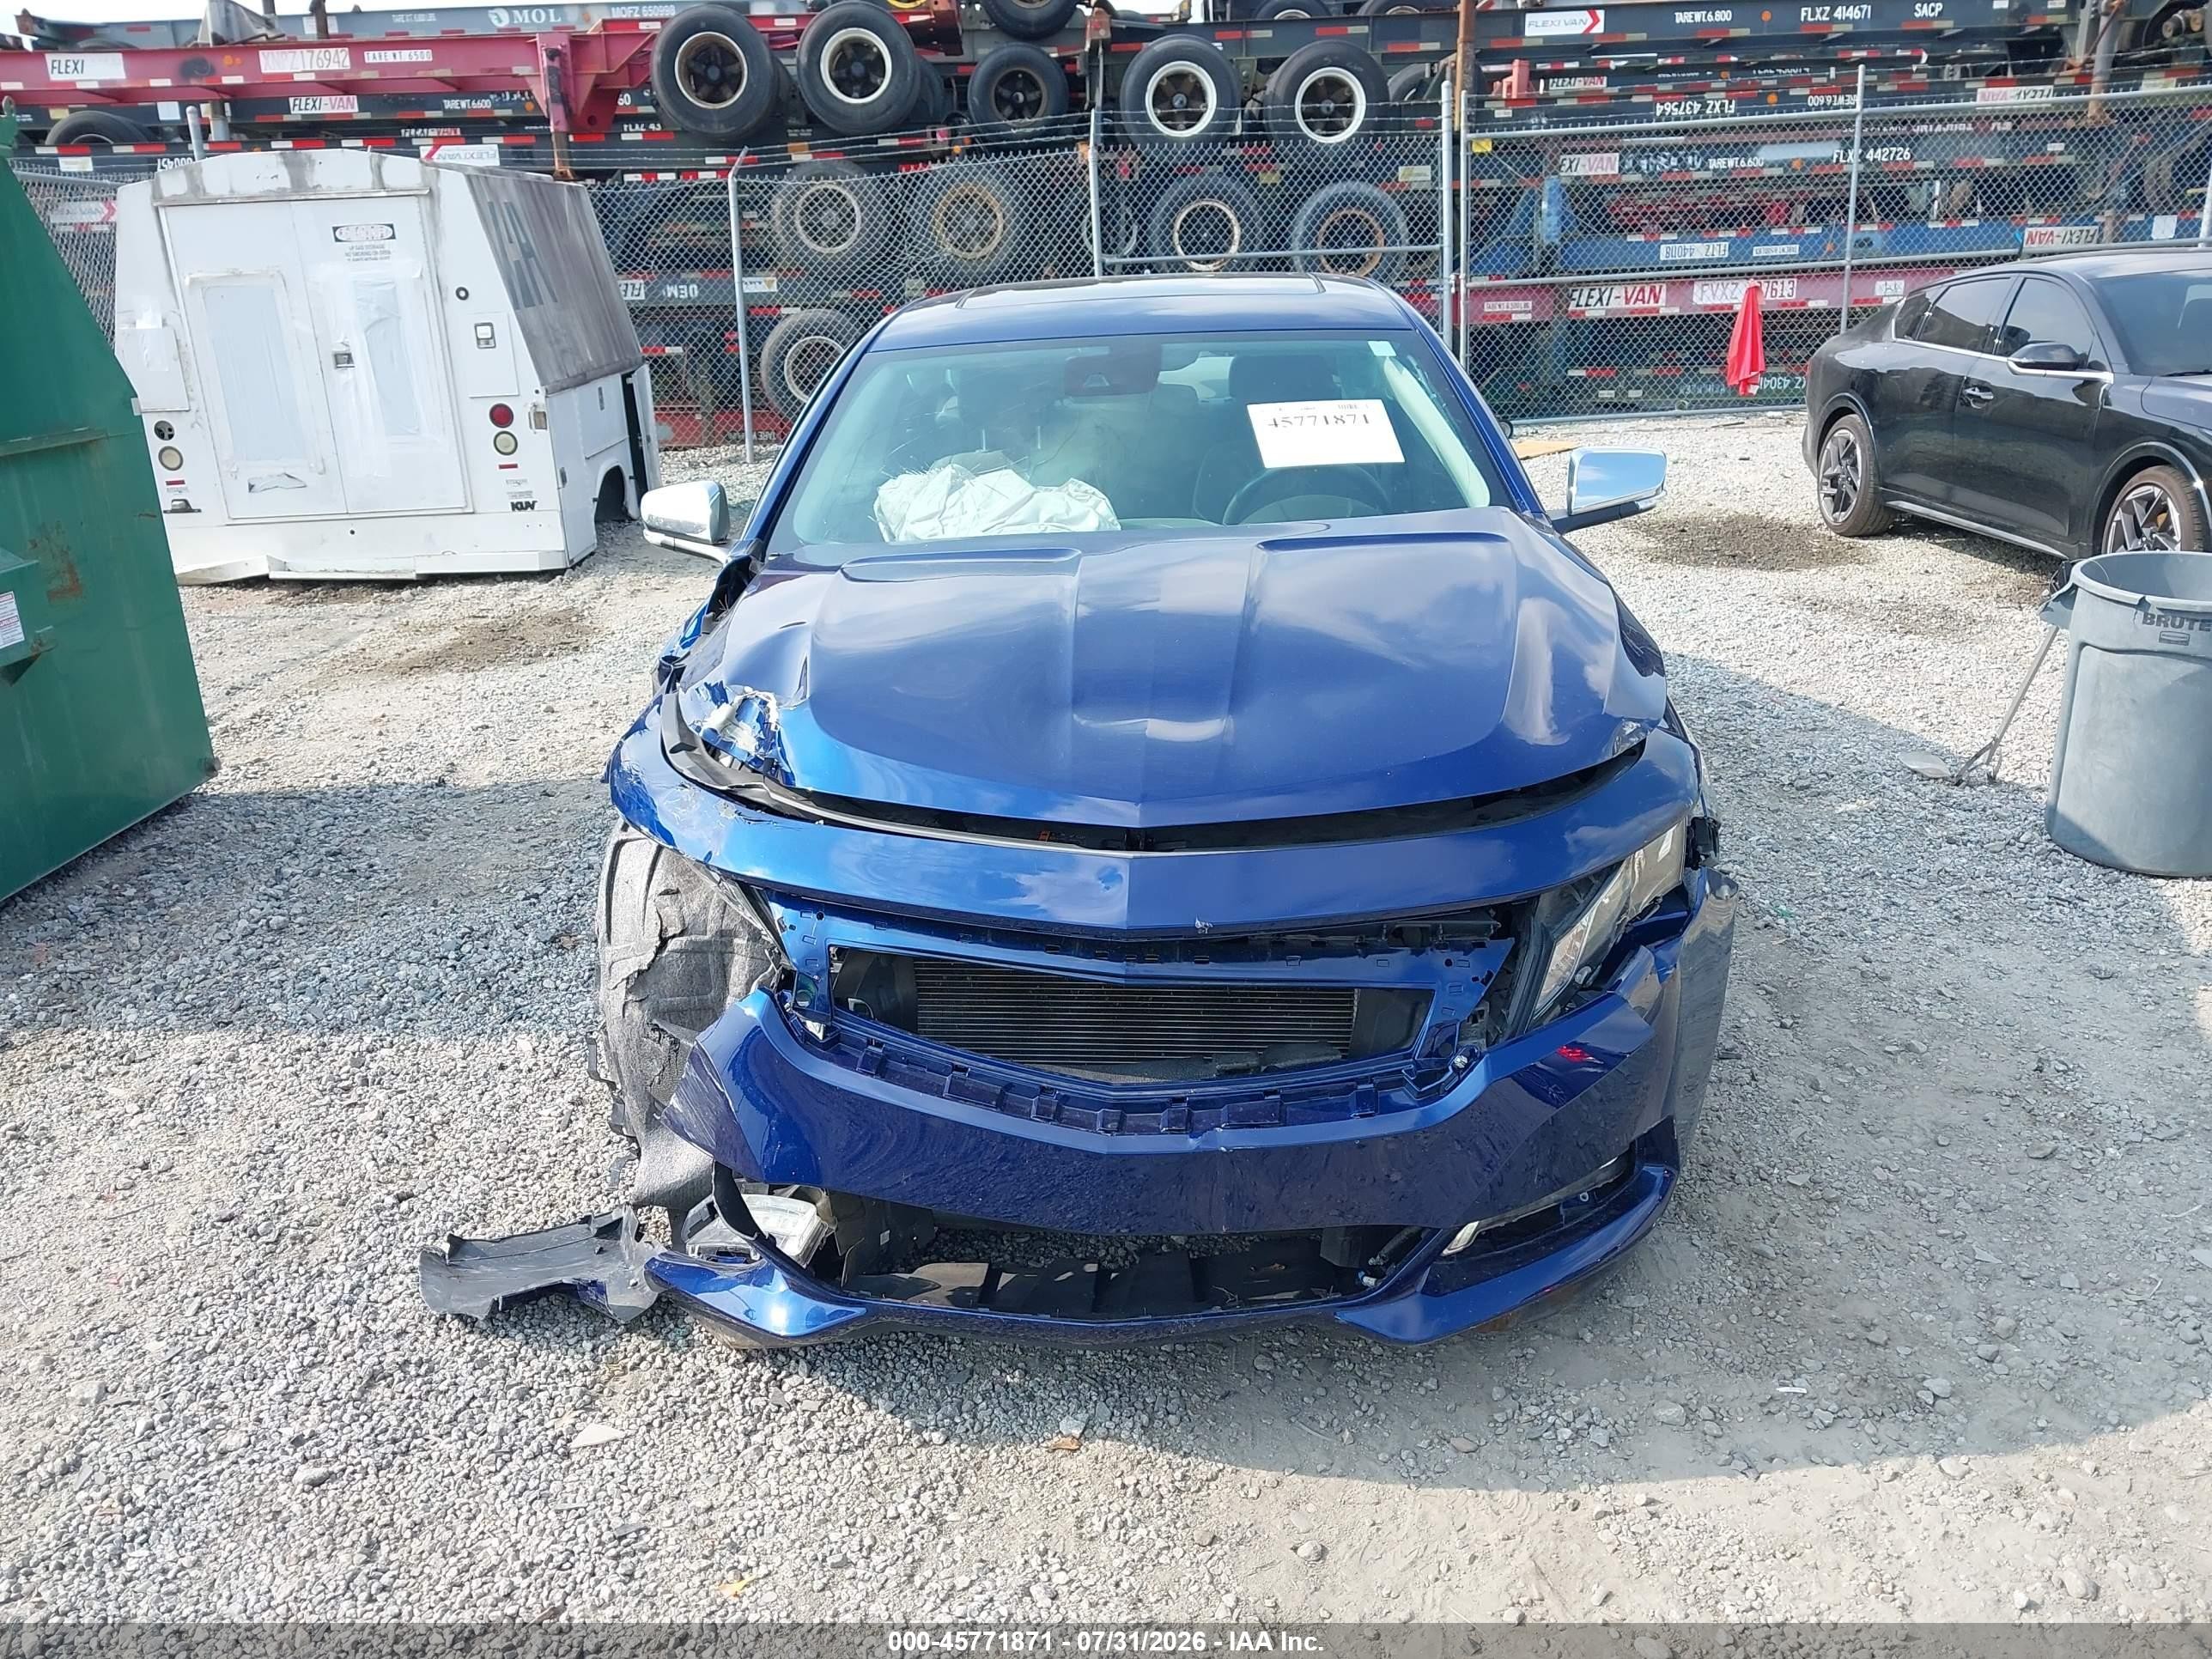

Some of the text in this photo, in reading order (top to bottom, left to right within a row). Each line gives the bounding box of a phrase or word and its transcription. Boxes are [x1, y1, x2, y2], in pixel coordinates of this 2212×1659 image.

[513, 9, 562, 24] MOL
[1801, 4, 1871, 21] FLXZ 414671
[1914, 3, 1943, 17] SACP
[51, 58, 85, 75] FLEXI
[292, 98, 356, 113] FLEXI-VAN
[1656, 100, 1735, 117] FLXZ 437564
[1865, 148, 1911, 162] 442726
[2025, 228, 2099, 246] FLEXI-VAN
[1567, 284, 1664, 307] FLEXI-VAN
[2142, 611, 2211, 632] BRUTE
